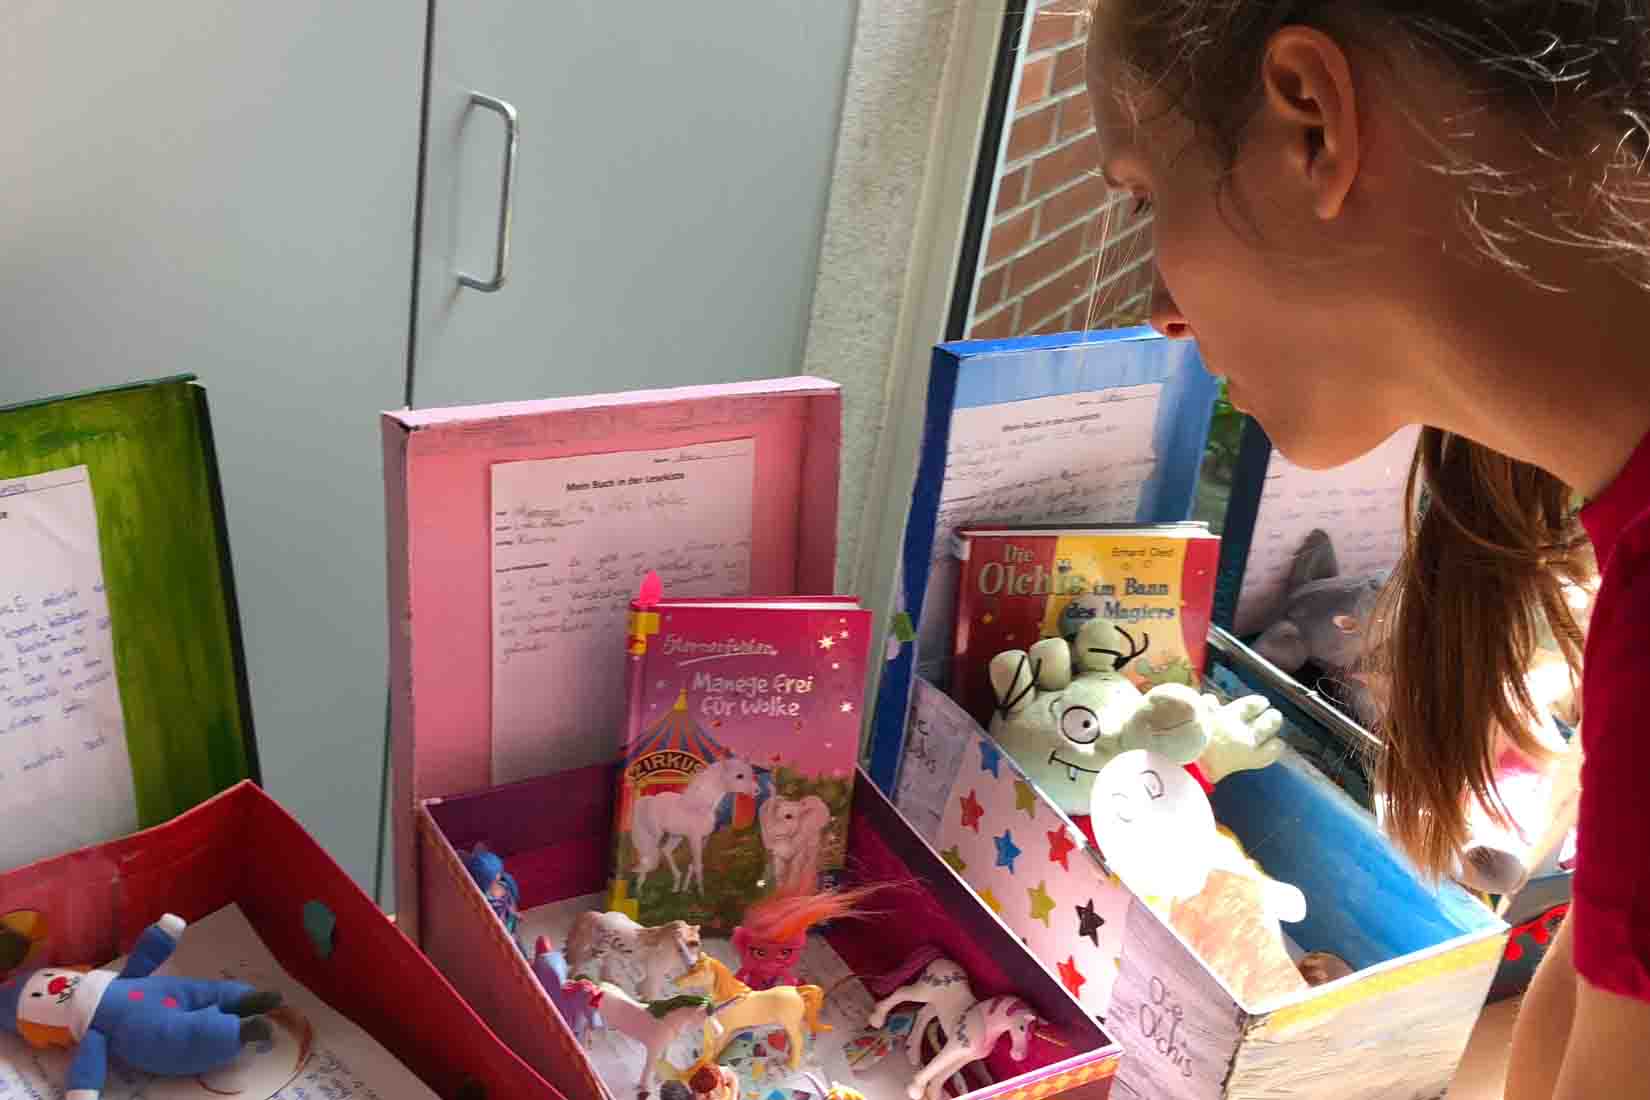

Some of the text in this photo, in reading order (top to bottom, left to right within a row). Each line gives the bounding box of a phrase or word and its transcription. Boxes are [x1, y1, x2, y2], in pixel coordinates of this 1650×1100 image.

[1004, 543, 1034, 563] Die
[1125, 576, 1169, 596] Bann
[1066, 601, 1097, 618] des
[692, 672, 769, 698] Manege
[740, 695, 801, 717] Wolke
